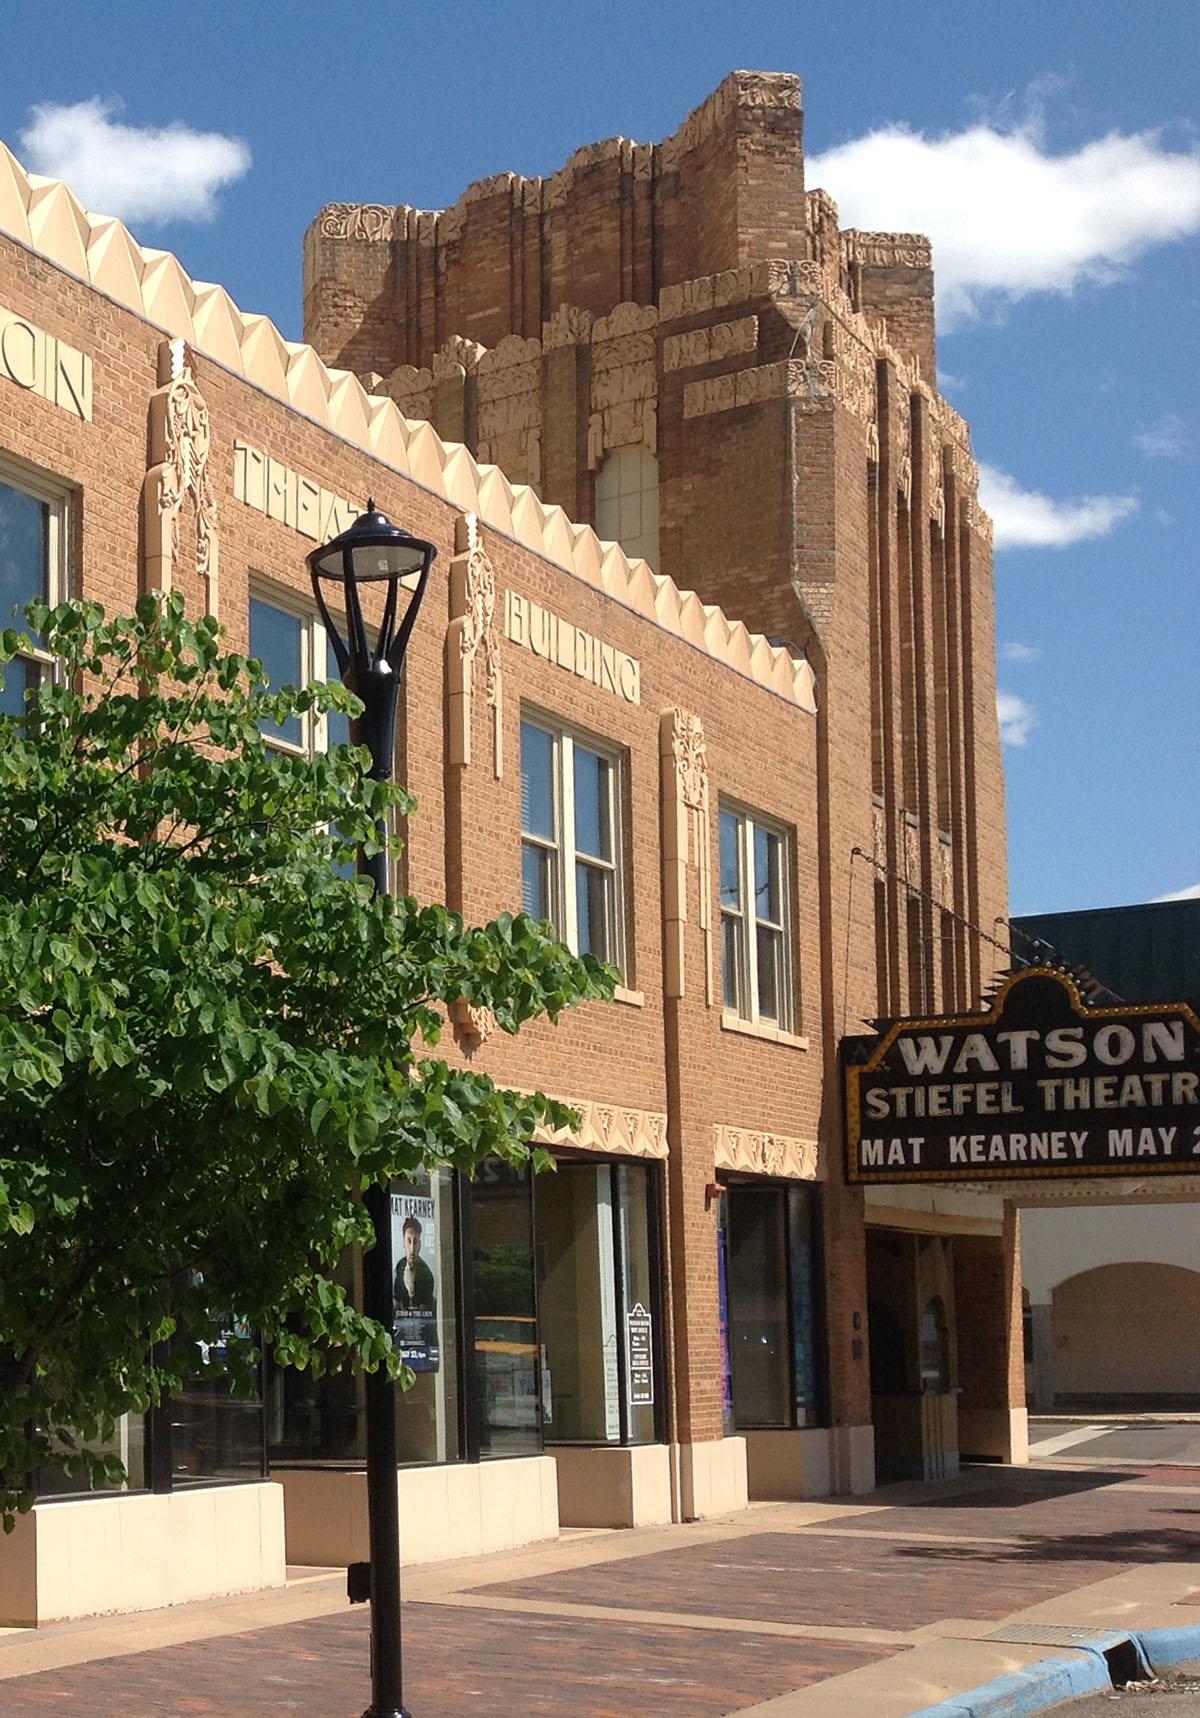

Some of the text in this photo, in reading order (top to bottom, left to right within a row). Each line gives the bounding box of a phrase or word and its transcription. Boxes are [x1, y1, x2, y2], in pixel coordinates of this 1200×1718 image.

[233, 438, 412, 580] THEA
[504, 588, 641, 705] BUILDING
[897, 1020, 1185, 1076] WATSON
[864, 1081, 1025, 1120] STIEFEL
[861, 1137, 926, 1167] MAT
[949, 1130, 1089, 1163] KEARNEY
[1108, 1126, 1178, 1158] MAY
